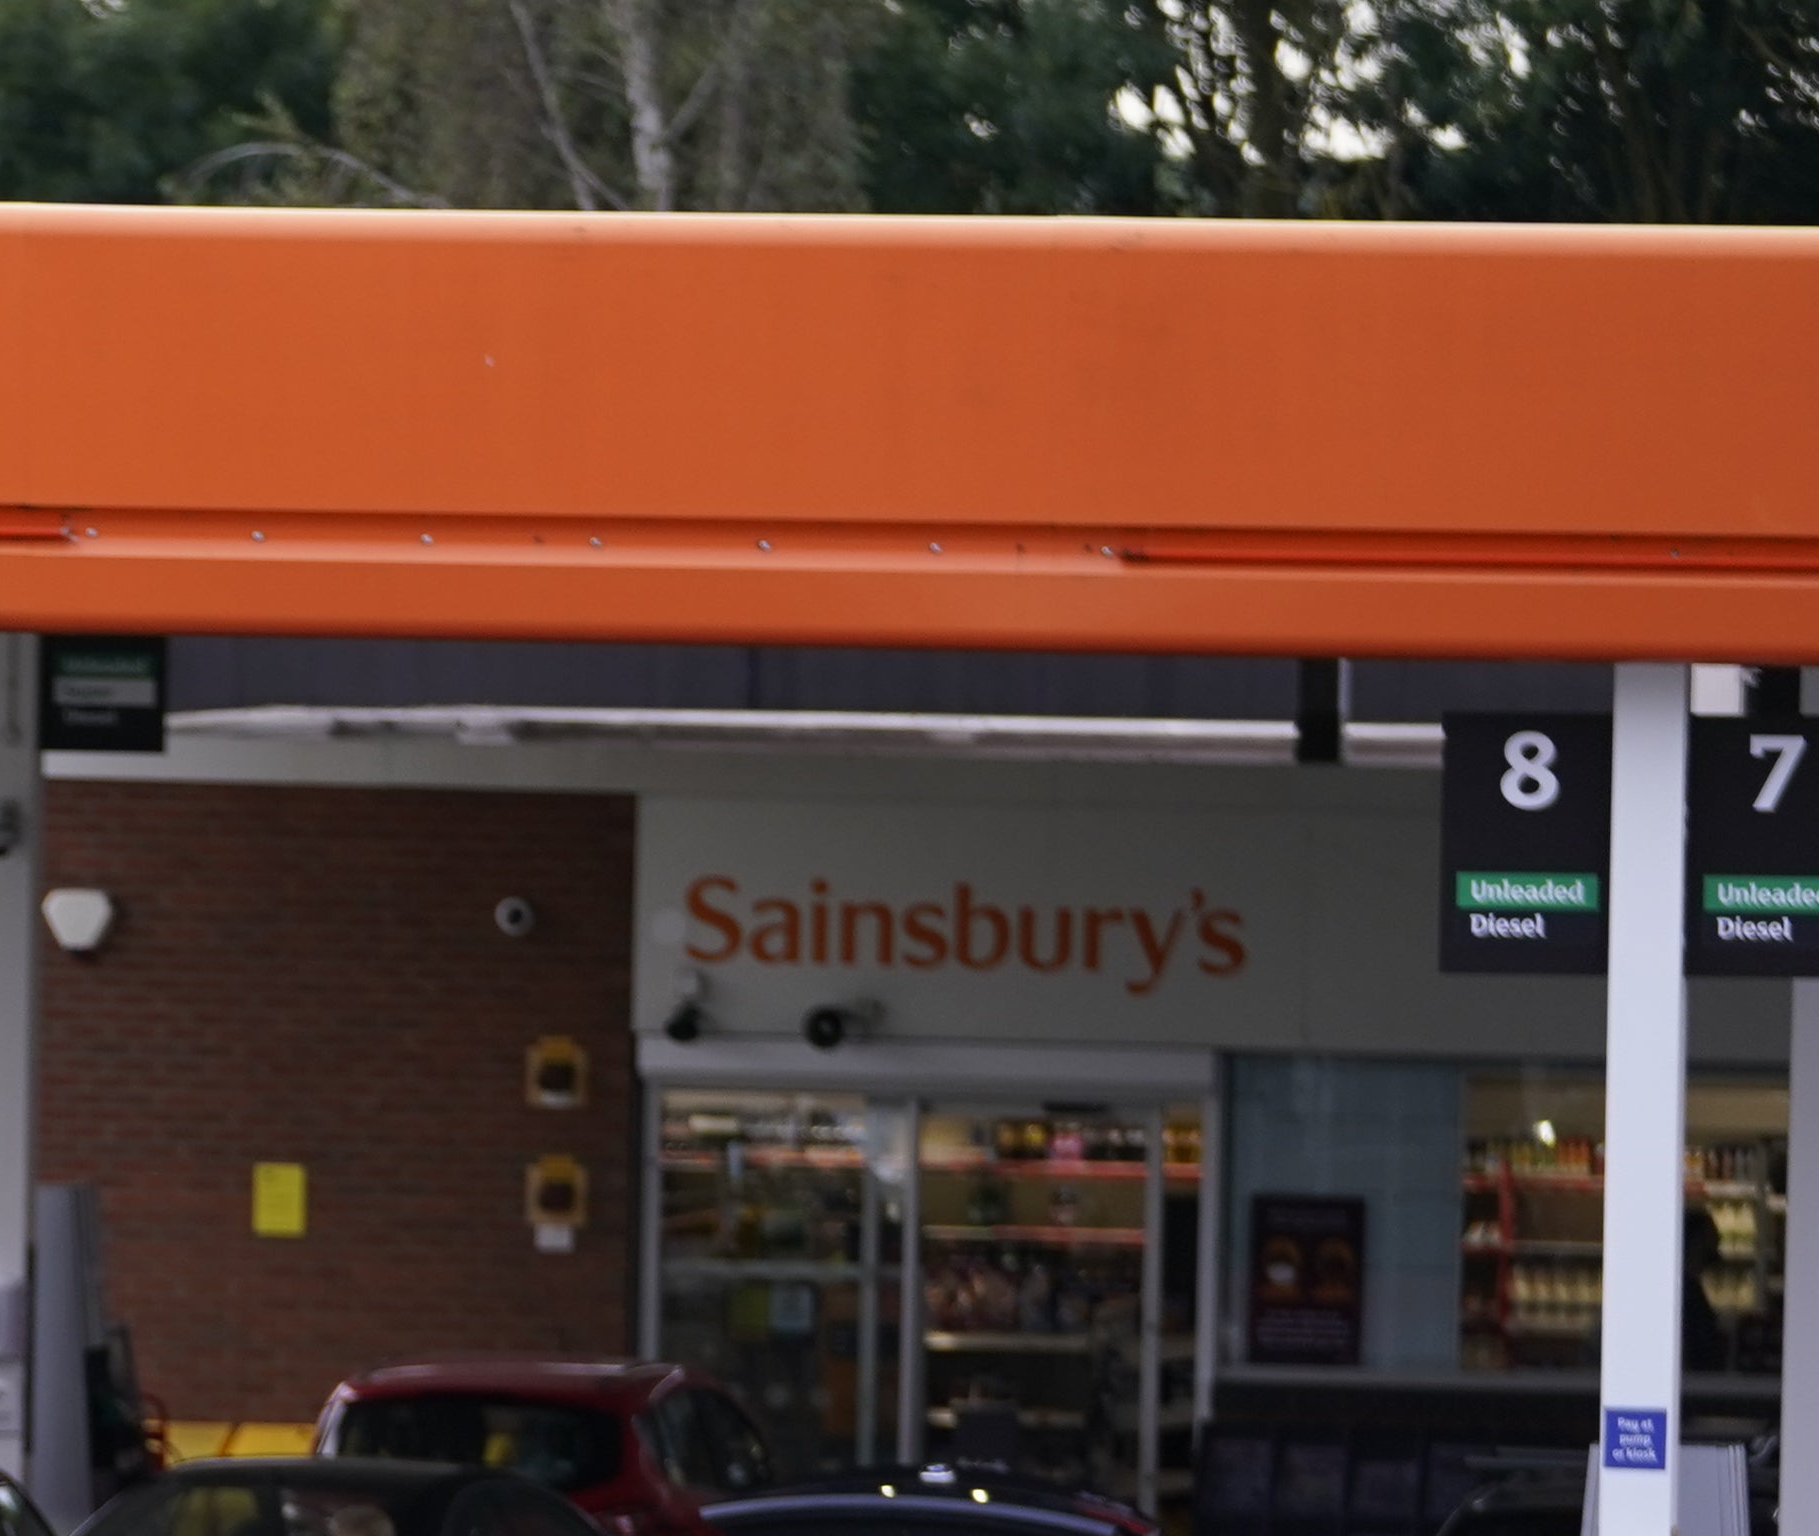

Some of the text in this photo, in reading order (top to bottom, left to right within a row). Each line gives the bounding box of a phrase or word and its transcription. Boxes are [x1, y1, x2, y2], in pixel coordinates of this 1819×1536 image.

[1499, 730, 1560, 811] 8
[1749, 734, 1808, 813] 7
[1470, 878, 1586, 903] Unleaded
[684, 874, 1247, 995] Sainsbury's
[1469, 912, 1547, 939] Diesel
[1715, 916, 1795, 942] Diesel
